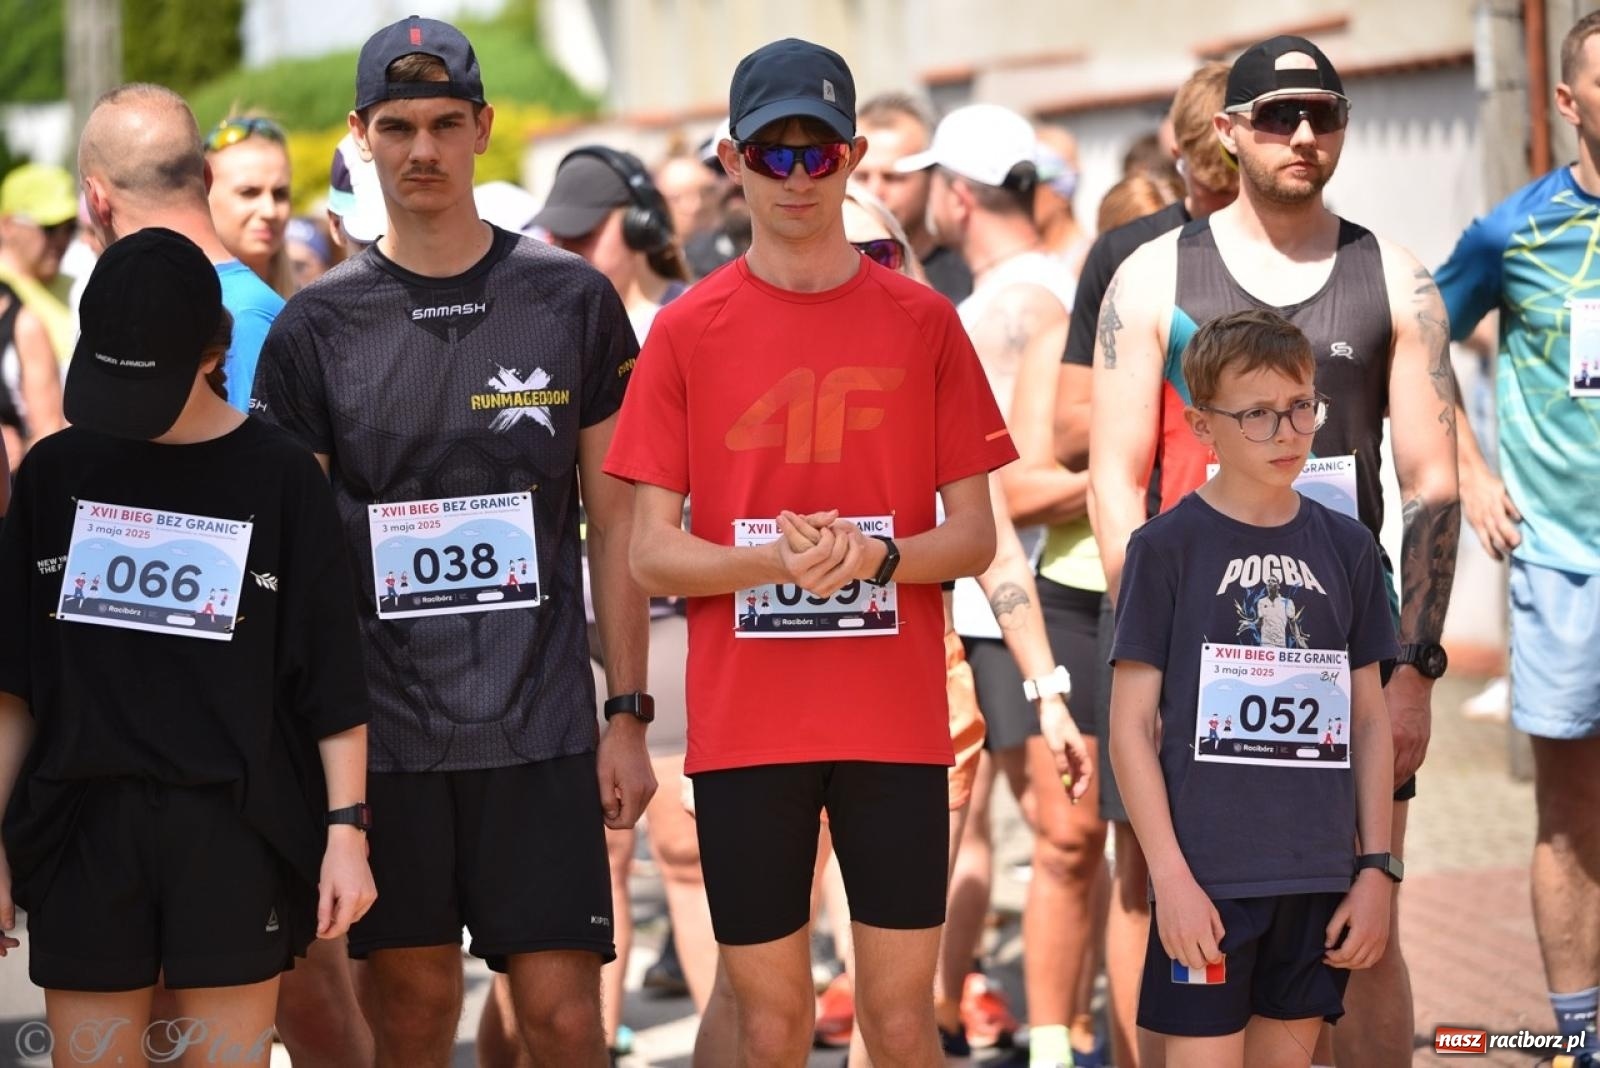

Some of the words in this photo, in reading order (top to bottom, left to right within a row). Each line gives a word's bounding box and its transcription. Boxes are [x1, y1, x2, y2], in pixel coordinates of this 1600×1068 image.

[411, 303, 486, 320] SMMASH
[95, 352, 118, 365] UNDER
[119, 359, 156, 368] ARMOUR
[470, 390, 570, 410] RUNMAGEDDON
[725, 366, 906, 464] 4F
[381, 505, 406, 517] XVII
[409, 503, 439, 515] BIEG
[442, 500, 467, 512] BEZ
[469, 496, 520, 510] GRANIC
[90, 505, 117, 520] XVII
[120, 509, 154, 524] BIEG
[156, 514, 182, 528] BEZ
[185, 518, 239, 535] GRANIC
[382, 524, 388, 532] 3
[390, 523, 415, 533] maja
[417, 520, 441, 530] 2025
[748, 523, 772, 534] XVII
[87, 523, 94, 532] 3
[96, 525, 122, 537] maja
[125, 528, 151, 540] 2025
[37, 557, 57, 568] NEW
[40, 565, 56, 575] THE
[413, 543, 499, 585] 038
[106, 555, 203, 603] 066
[1216, 554, 1327, 595] POGBA
[1215, 647, 1241, 659] XVII
[1244, 649, 1275, 661] BIEG
[1279, 651, 1301, 663] BEZ
[1304, 652, 1342, 665] GRANIC
[1214, 665, 1220, 673] 3
[1222, 666, 1248, 676] maja
[1250, 667, 1274, 677] 2025
[1239, 694, 1320, 735] 052
